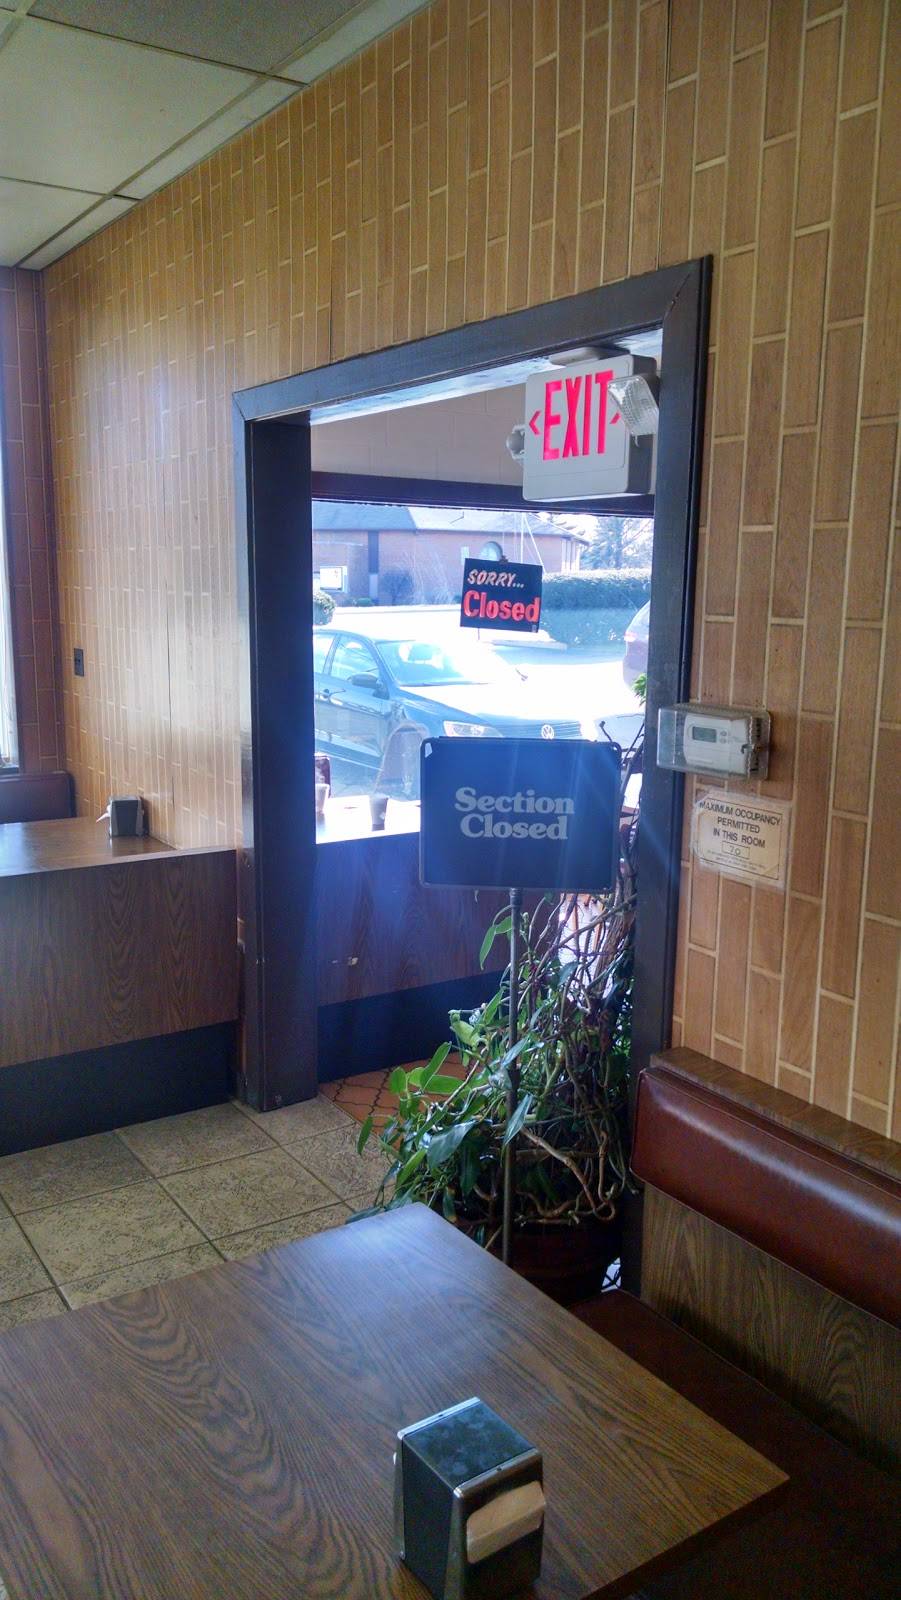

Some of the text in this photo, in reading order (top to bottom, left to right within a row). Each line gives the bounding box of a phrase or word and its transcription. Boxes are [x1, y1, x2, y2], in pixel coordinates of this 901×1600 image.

[543, 370, 613, 460] EXIT
[467, 569, 524, 588] SORRY...
[463, 589, 541, 623] Closed
[454, 787, 575, 815] Section
[699, 800, 781, 826] MAXIMUM OCCUPANCY
[460, 813, 568, 840] Closed
[713, 828, 766, 848] IN THIS ROOM
[717, 816, 760, 834] PERMITTED
